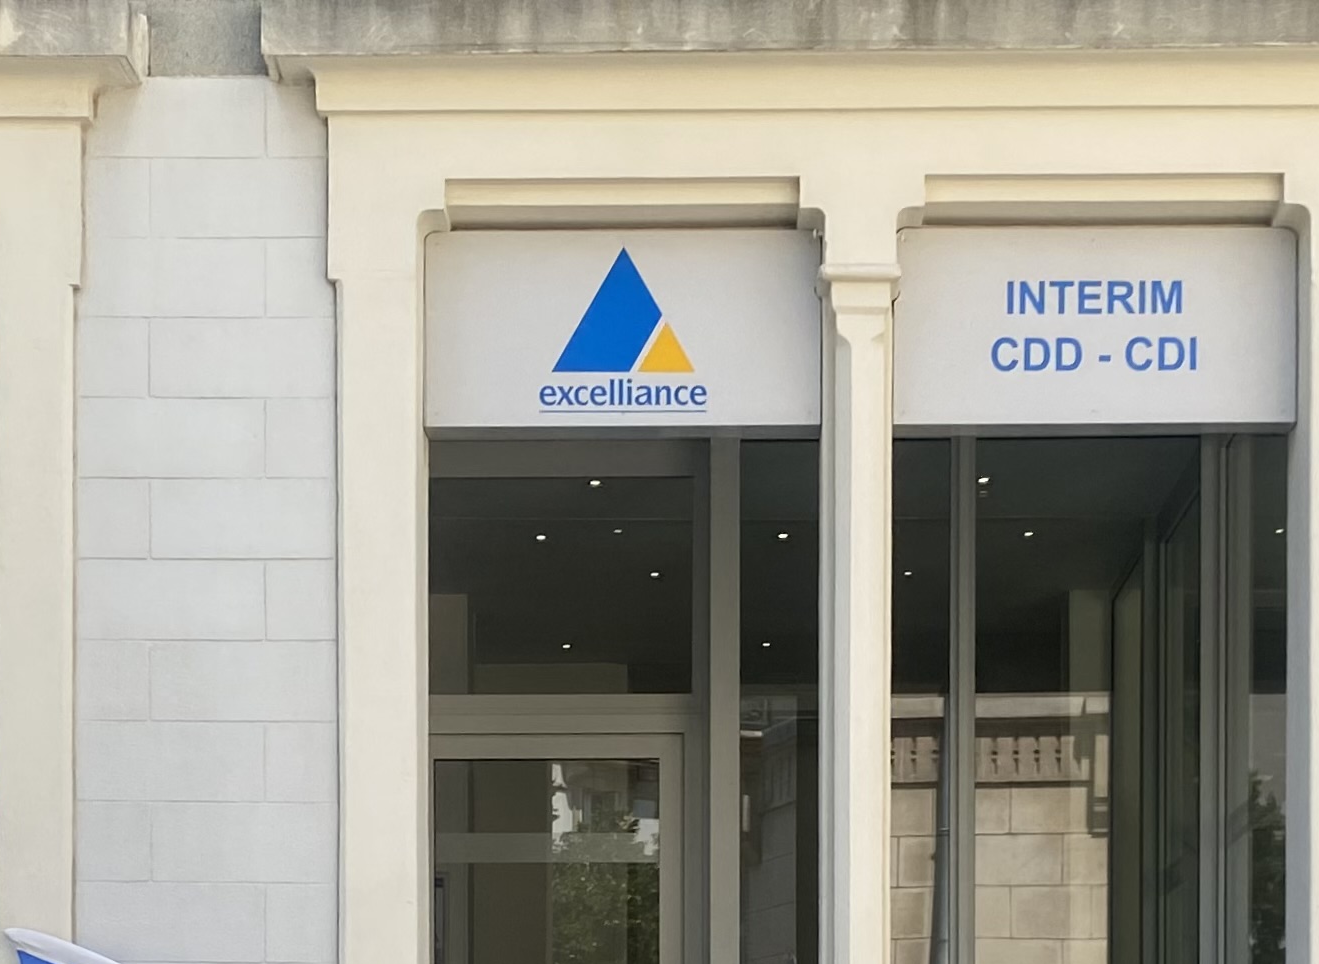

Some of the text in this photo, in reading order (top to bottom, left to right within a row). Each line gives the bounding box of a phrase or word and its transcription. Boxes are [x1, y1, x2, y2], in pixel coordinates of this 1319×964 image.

[1007, 280, 1183, 315] INTERIM
[990, 337, 1082, 373] CDD
[1124, 337, 1199, 373] CDI
[539, 378, 708, 407] excelliance
